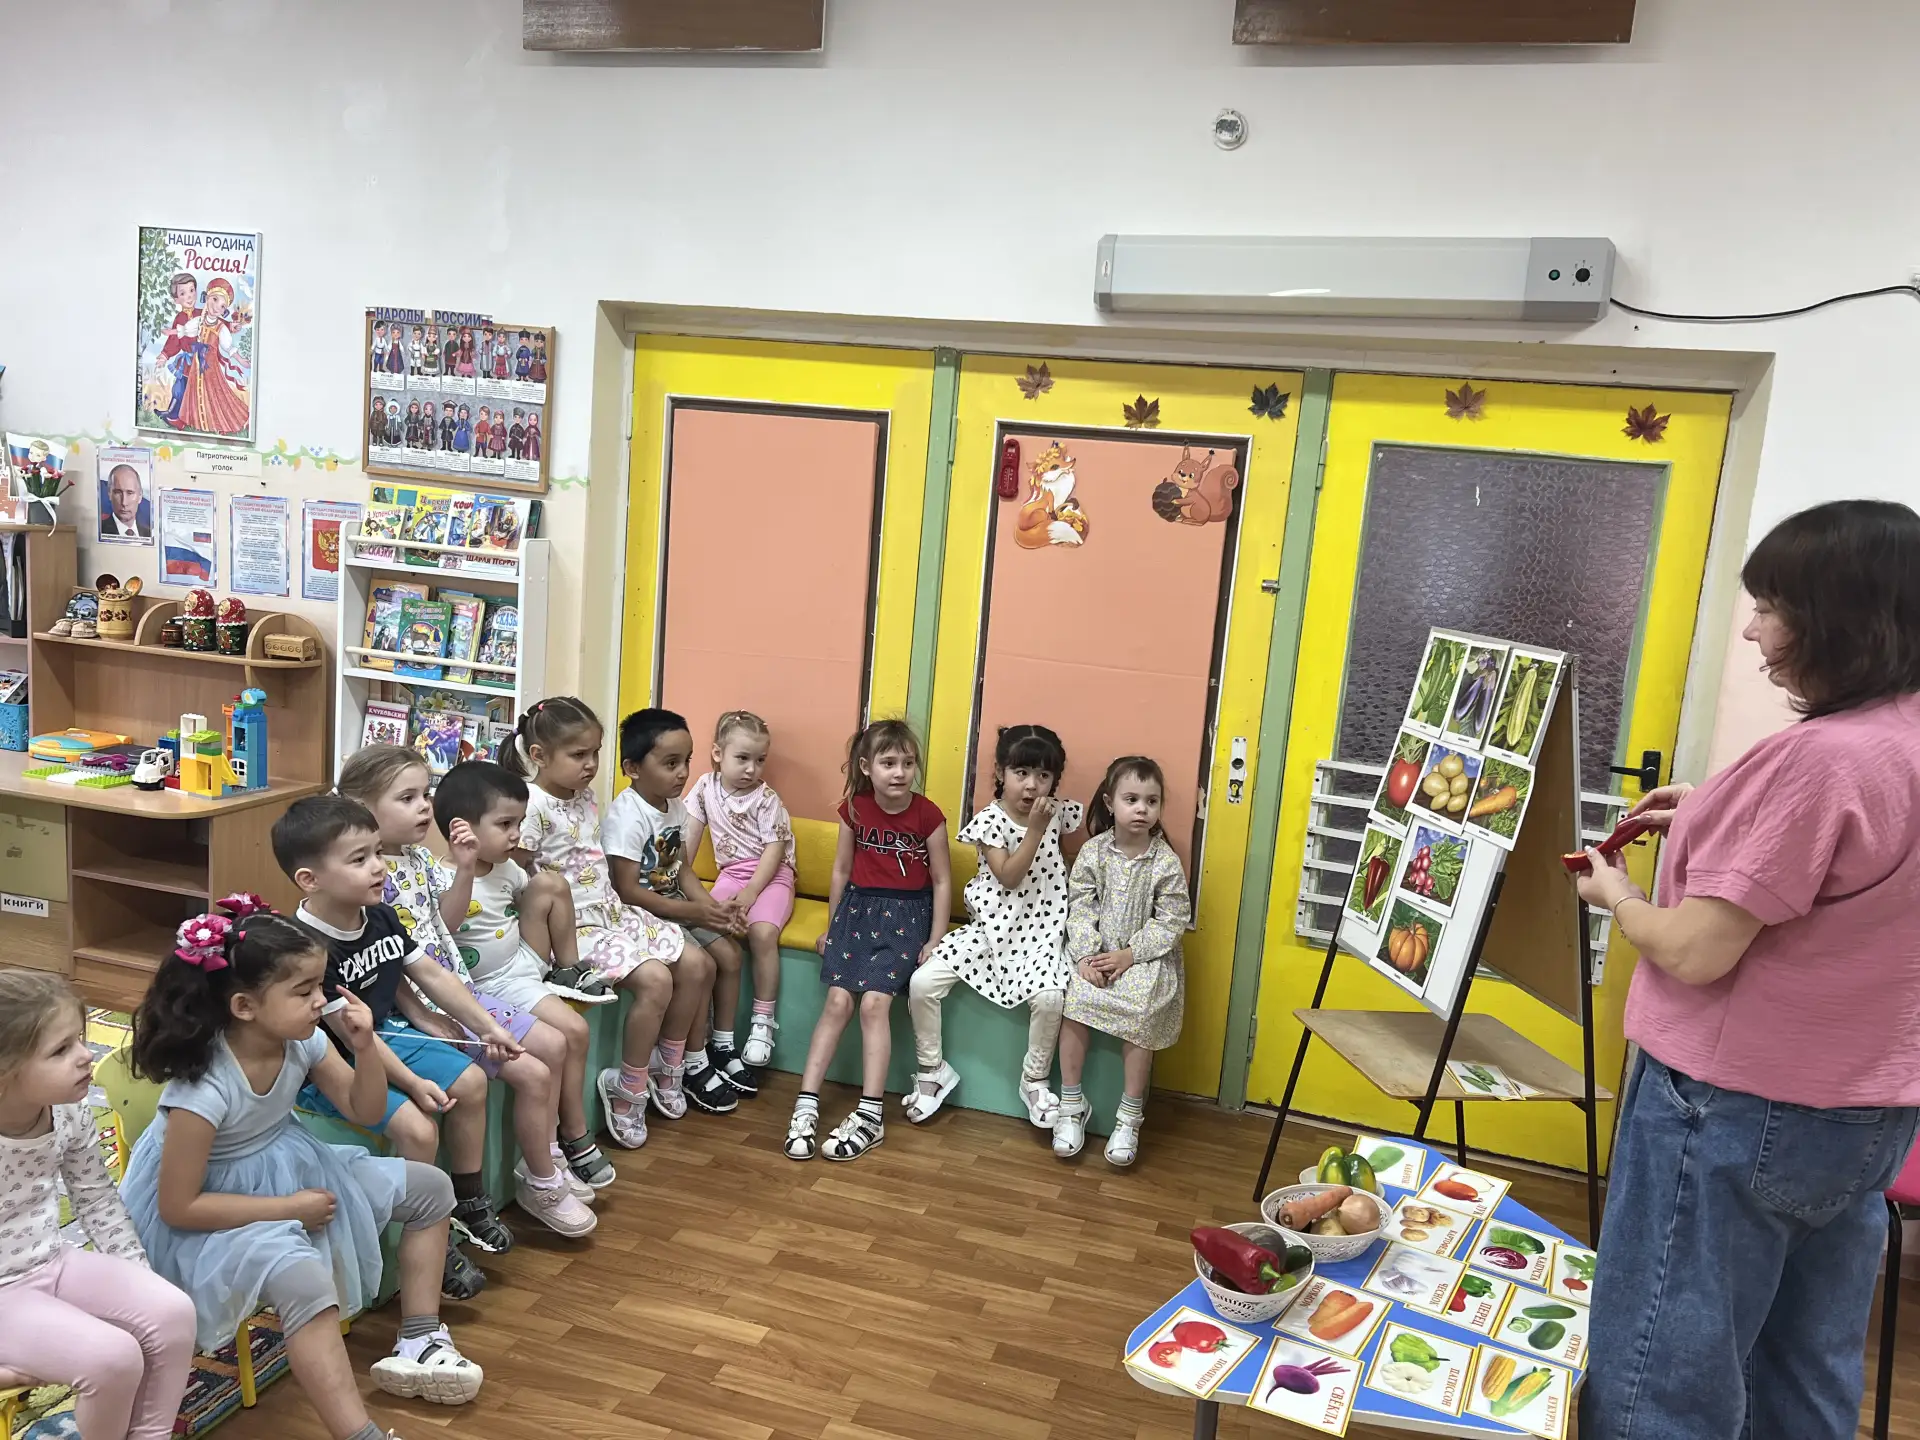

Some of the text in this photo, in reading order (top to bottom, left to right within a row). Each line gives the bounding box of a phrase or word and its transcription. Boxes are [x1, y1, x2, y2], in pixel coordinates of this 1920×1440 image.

[168, 233, 254, 252] НАША РОДИНА
[184, 248, 249, 274] Россия!
[376, 307, 482, 327] НАРОДЫ РОССИИ
[196, 451, 248, 461] Патриотический
[368, 545, 394, 558] СКАЗКИ
[4, 898, 44, 910] КНИГИ
[1473, 1203, 1488, 1217] ЛУК
[1436, 1230, 1458, 1256] КАРТОФЕЛЬ
[1530, 1255, 1547, 1281] КАПУСТА
[1300, 1281, 1326, 1308] МОРКОВЬ
[1429, 1283, 1448, 1307] ЧЕСНОК
[1471, 1302, 1492, 1327] ПЕРЕЦ
[1563, 1333, 1582, 1360] ОГУРЕЦ
[1195, 1358, 1227, 1390] ПОМИДОР
[1441, 1367, 1460, 1407] ПАТИССОН
[1322, 1386, 1345, 1424] СВЁКЛА
[1544, 1396, 1558, 1432] КУКУРУЗА
